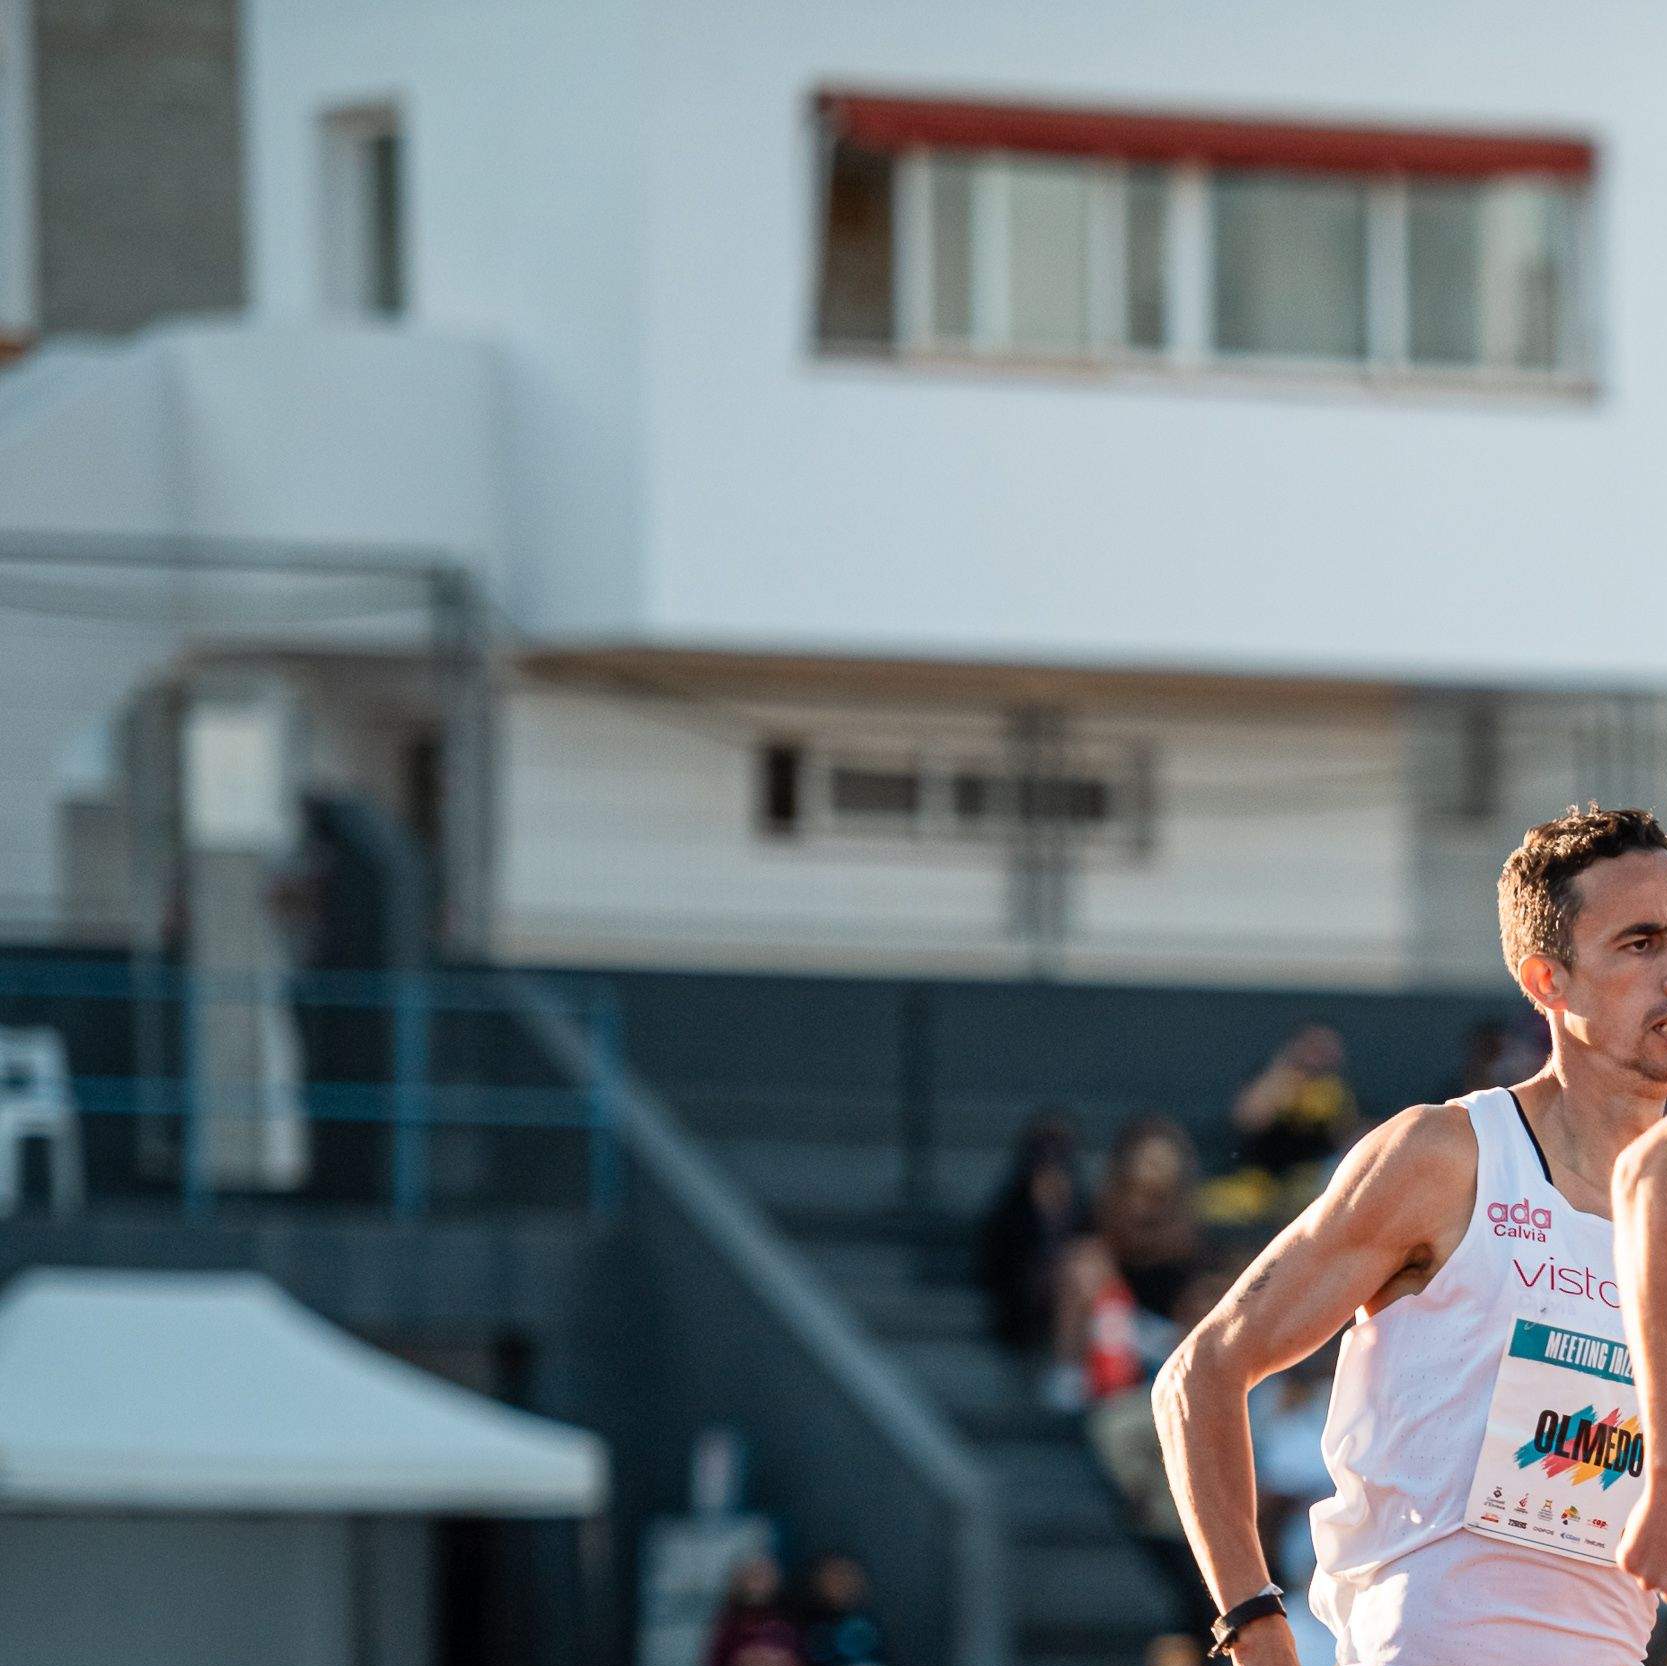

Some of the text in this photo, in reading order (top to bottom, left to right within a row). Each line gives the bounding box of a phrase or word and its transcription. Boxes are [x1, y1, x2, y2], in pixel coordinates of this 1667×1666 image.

[1487, 1198, 1552, 1230] ada
[1494, 1223, 1546, 1243] Calvià
[1545, 1330, 1609, 1370] MEETING
[1534, 1409, 1645, 1478] OLMEDO
